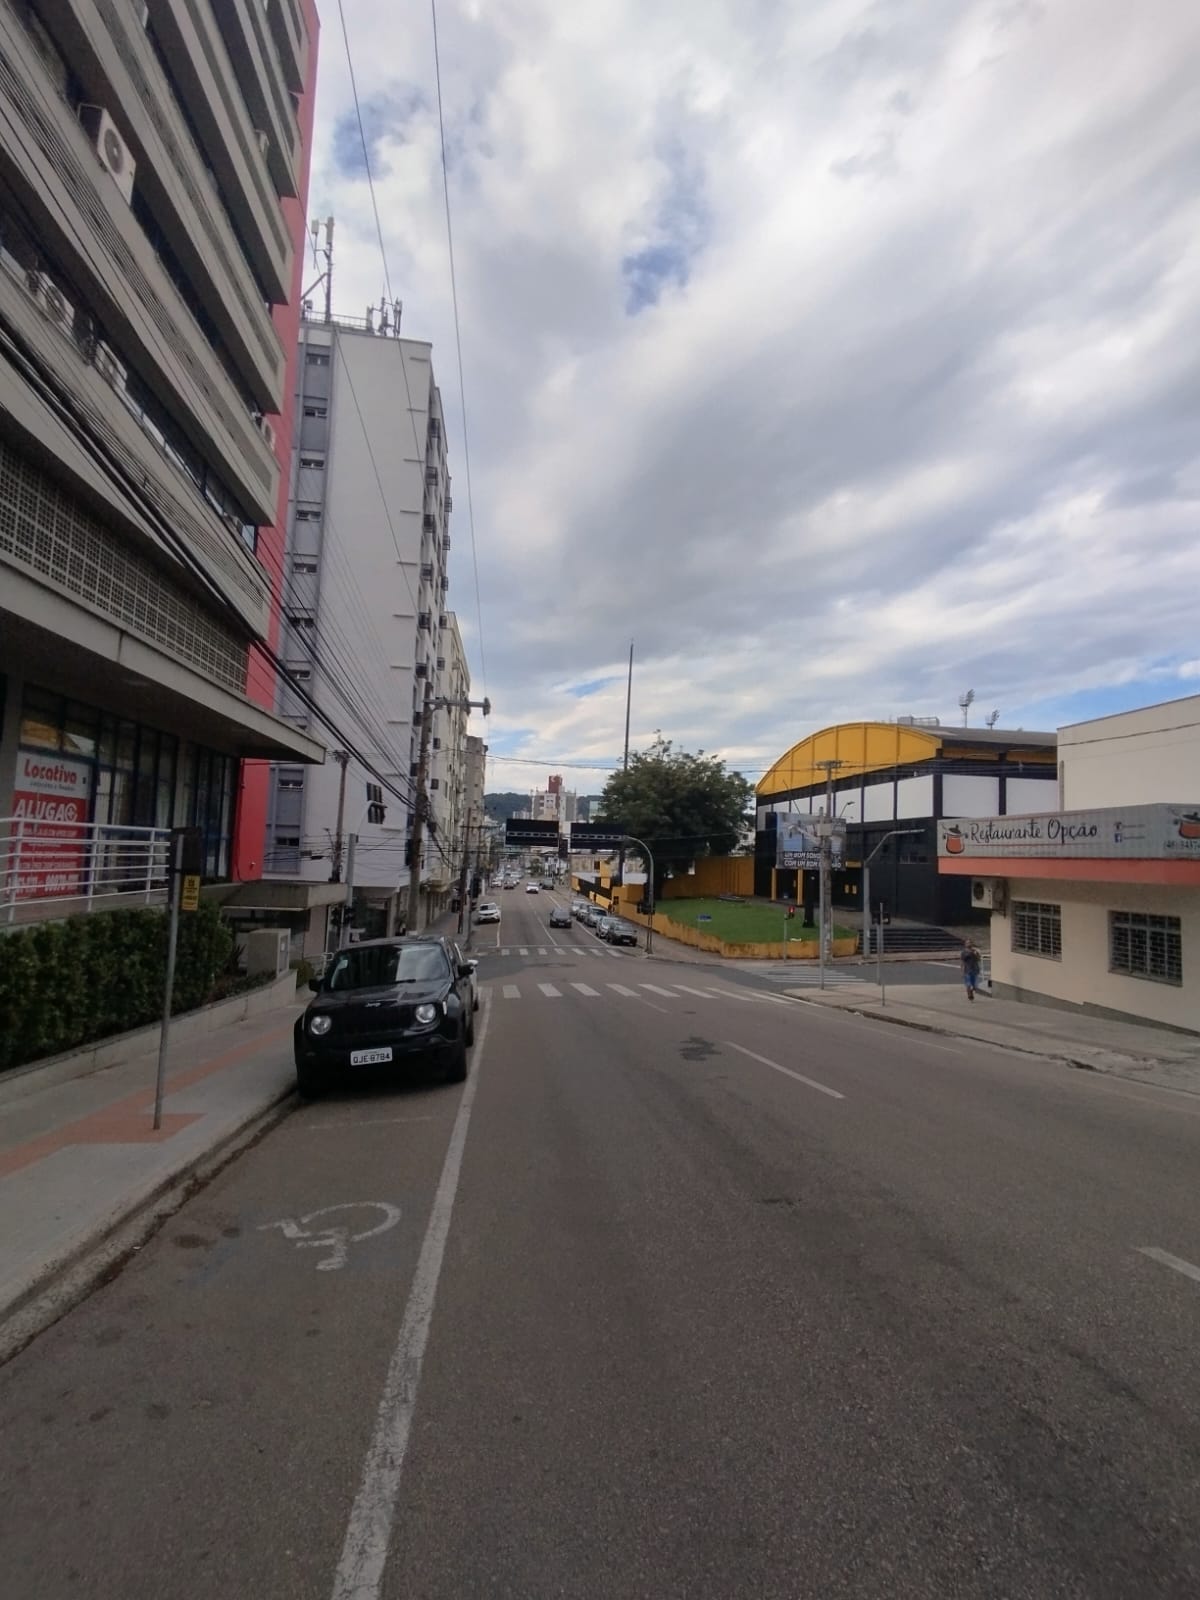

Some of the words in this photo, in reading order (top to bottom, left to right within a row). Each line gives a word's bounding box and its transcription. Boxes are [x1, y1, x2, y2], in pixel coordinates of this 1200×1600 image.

[24, 758, 77, 784] Locativa
[970, 819, 1041, 843] Restaurante
[1047, 818, 1098, 844] Opção
